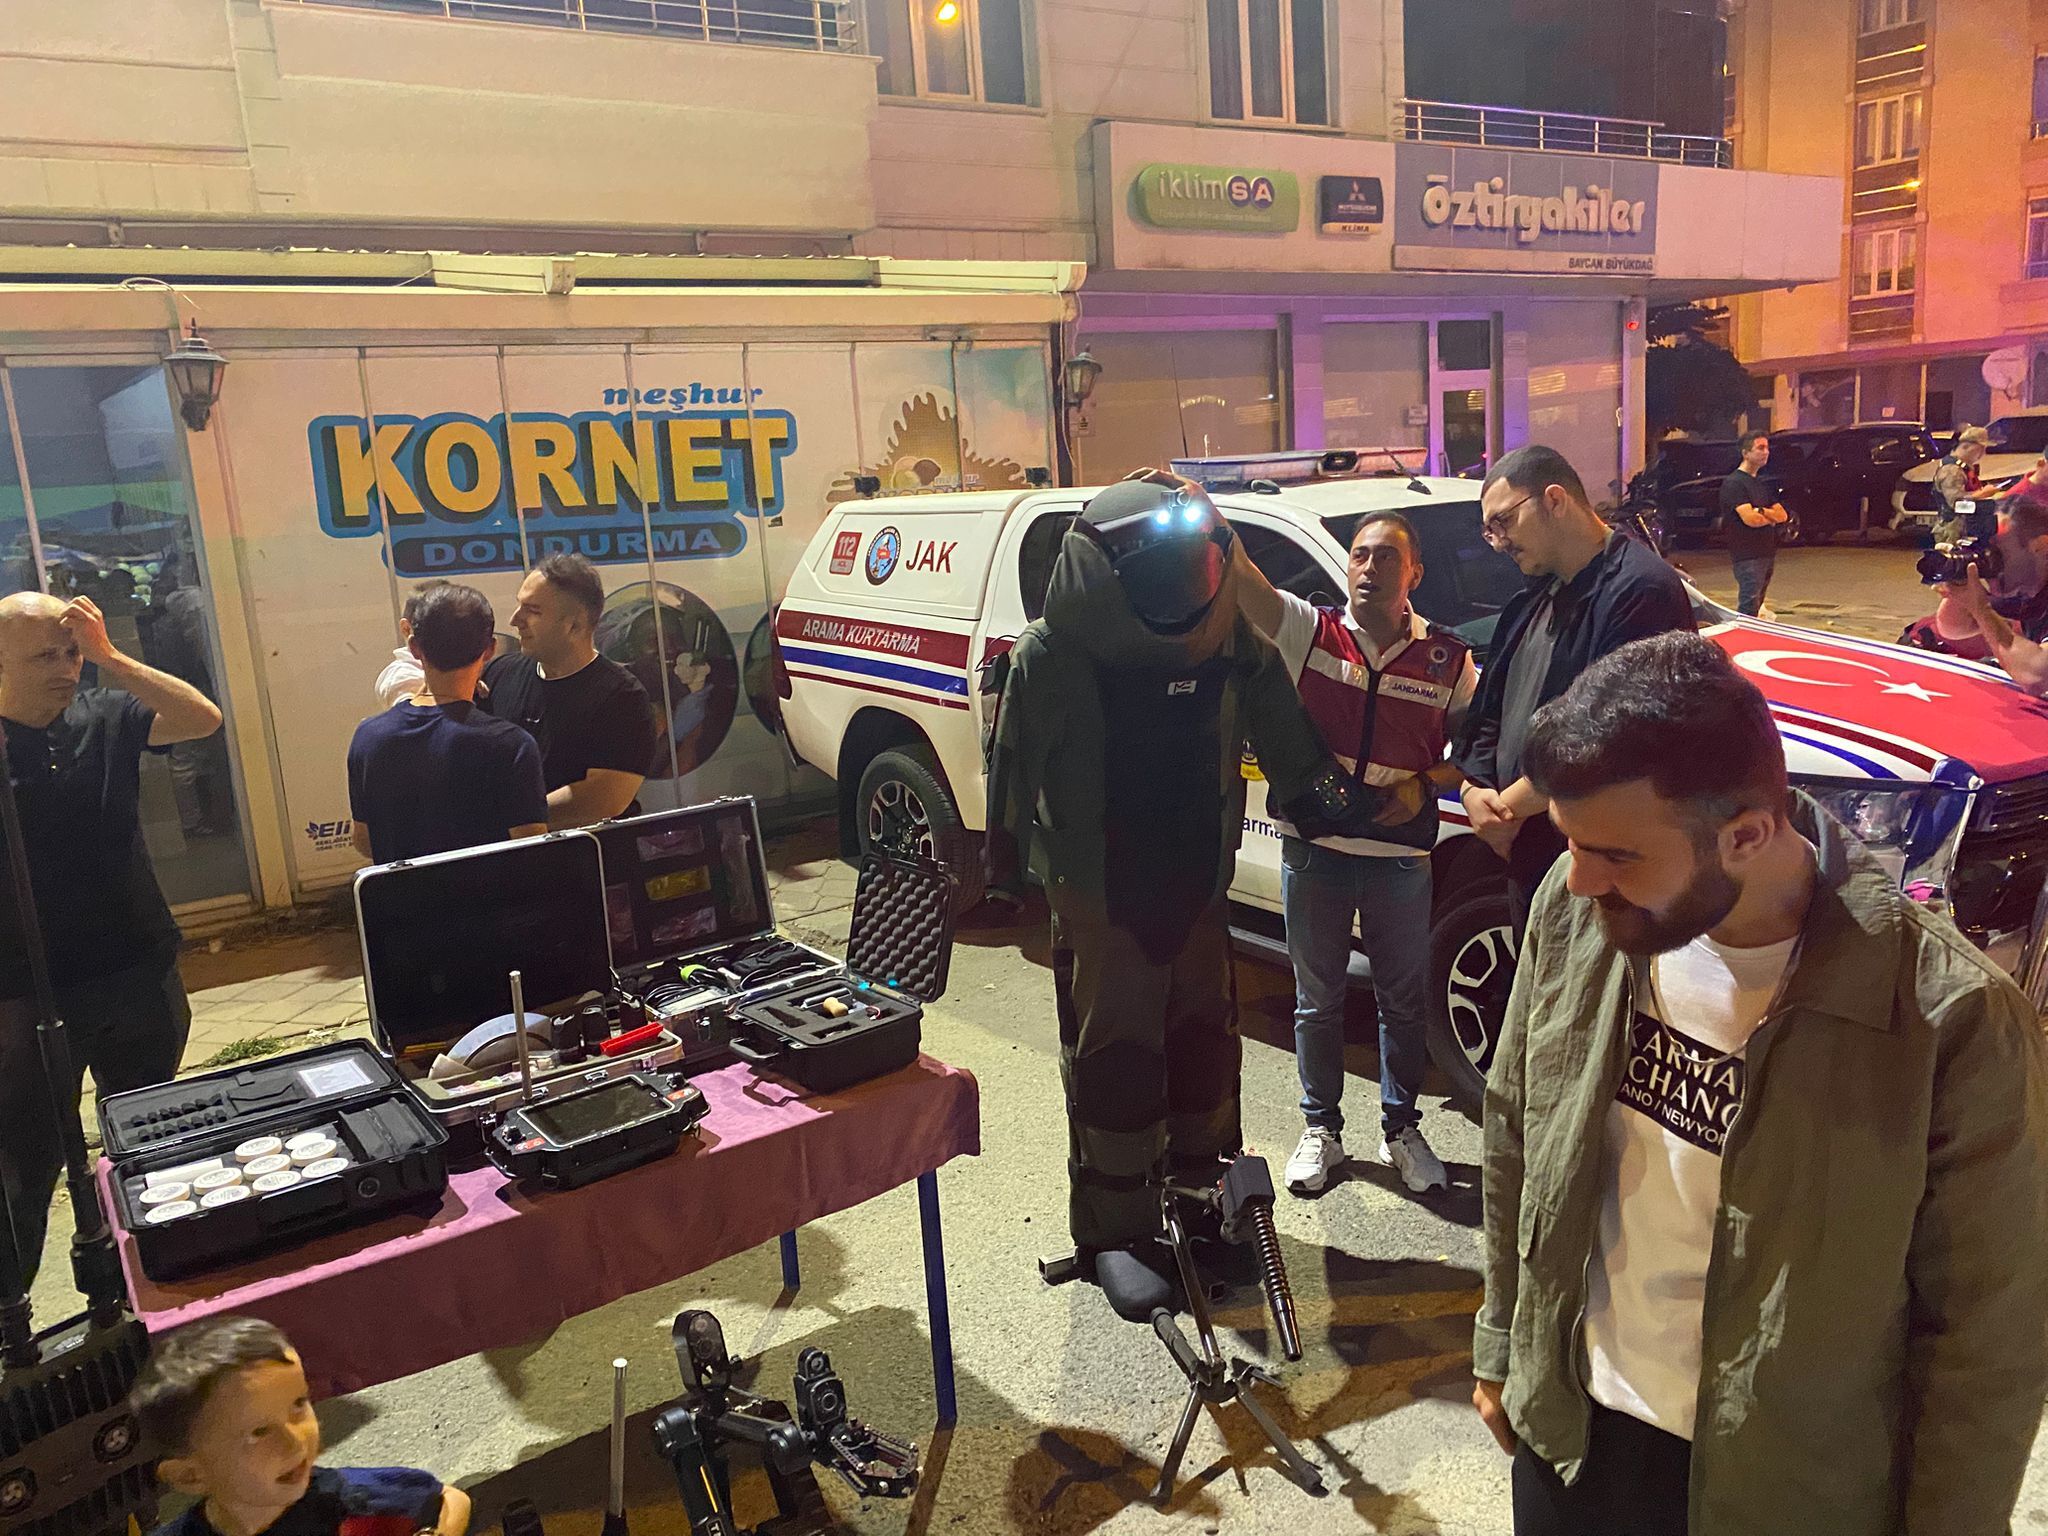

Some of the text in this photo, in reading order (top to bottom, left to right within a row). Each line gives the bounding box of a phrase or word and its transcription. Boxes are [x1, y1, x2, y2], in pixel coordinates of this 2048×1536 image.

[602, 382, 763, 411] meşhur
[328, 417, 789, 522] KORNET
[422, 527, 722, 567] DONDURMA
[838, 536, 857, 557] 112
[905, 539, 959, 574] JAK
[802, 618, 921, 654] ARAMA KURTARMA
